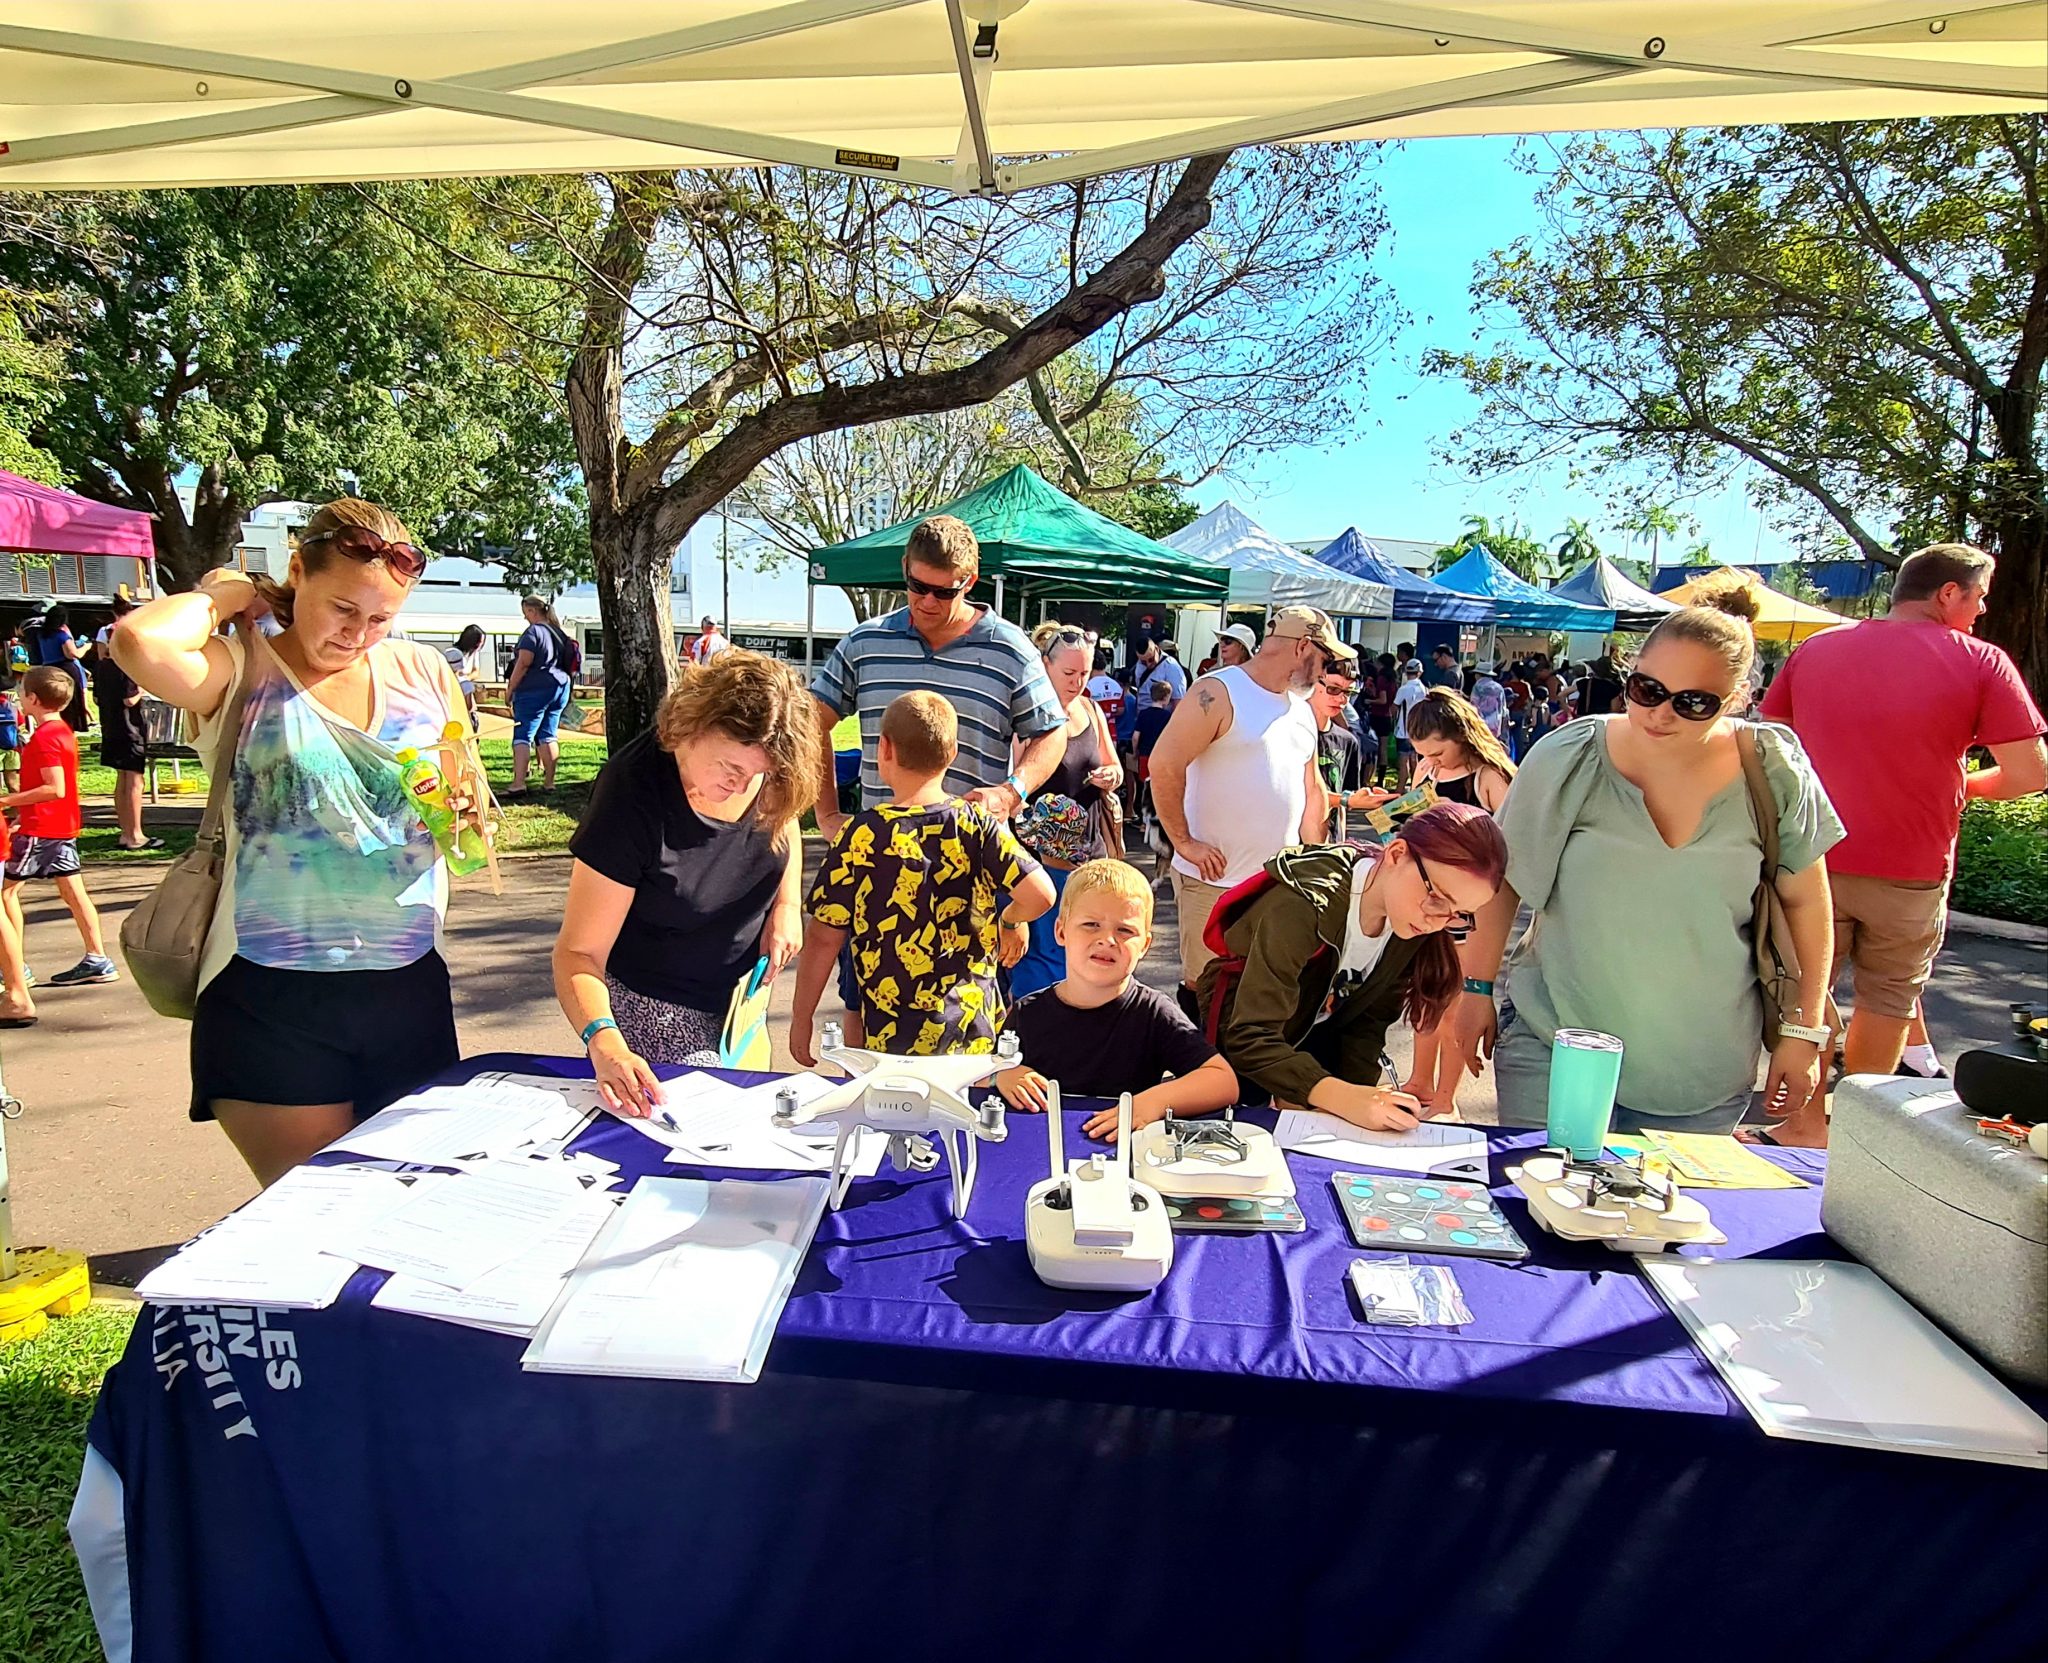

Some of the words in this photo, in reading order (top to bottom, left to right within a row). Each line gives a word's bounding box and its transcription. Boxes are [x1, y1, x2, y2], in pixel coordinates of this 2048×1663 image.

[839, 150, 870, 161] SECURE
[871, 155, 897, 164] STRAP
[745, 637, 776, 646] DON'T
